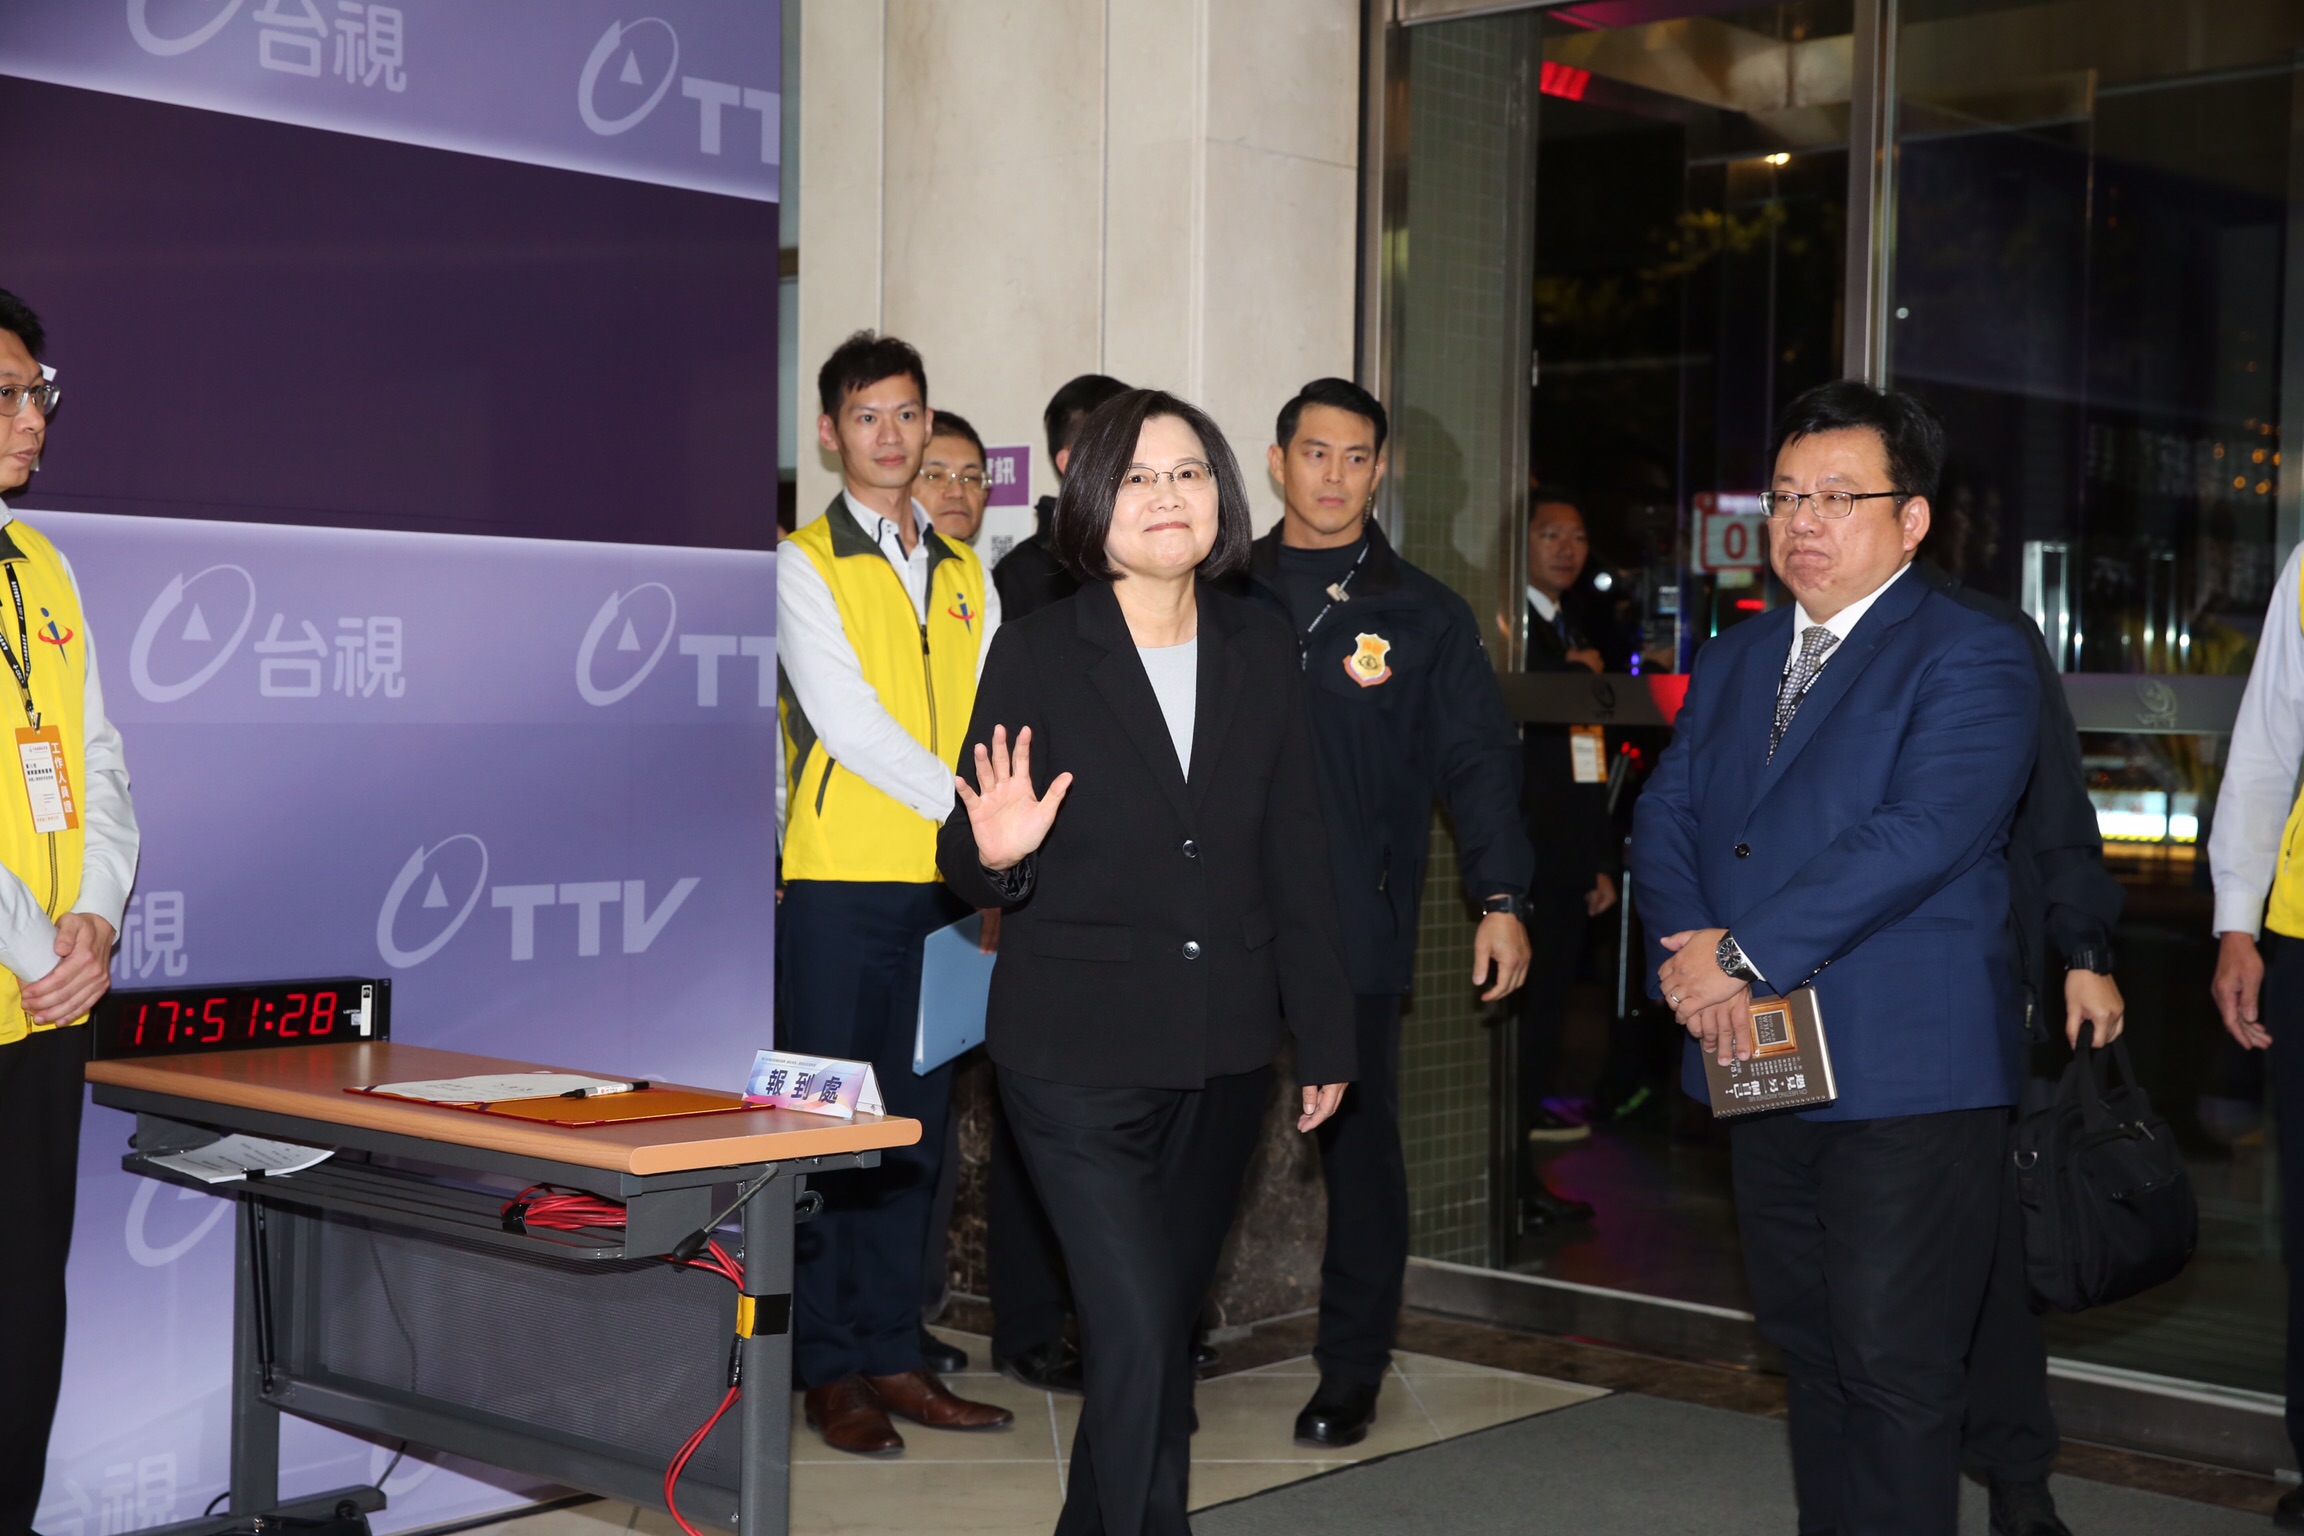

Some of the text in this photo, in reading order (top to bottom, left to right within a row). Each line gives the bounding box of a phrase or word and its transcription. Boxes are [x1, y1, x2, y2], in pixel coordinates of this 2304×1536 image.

[252, 0, 407, 93] 台視
[254, 612, 406, 698] 台視
[491, 877, 701, 961] TTV
[134, 991, 339, 1046] 17:51:28
[766, 1068, 842, 1104] 報到處
